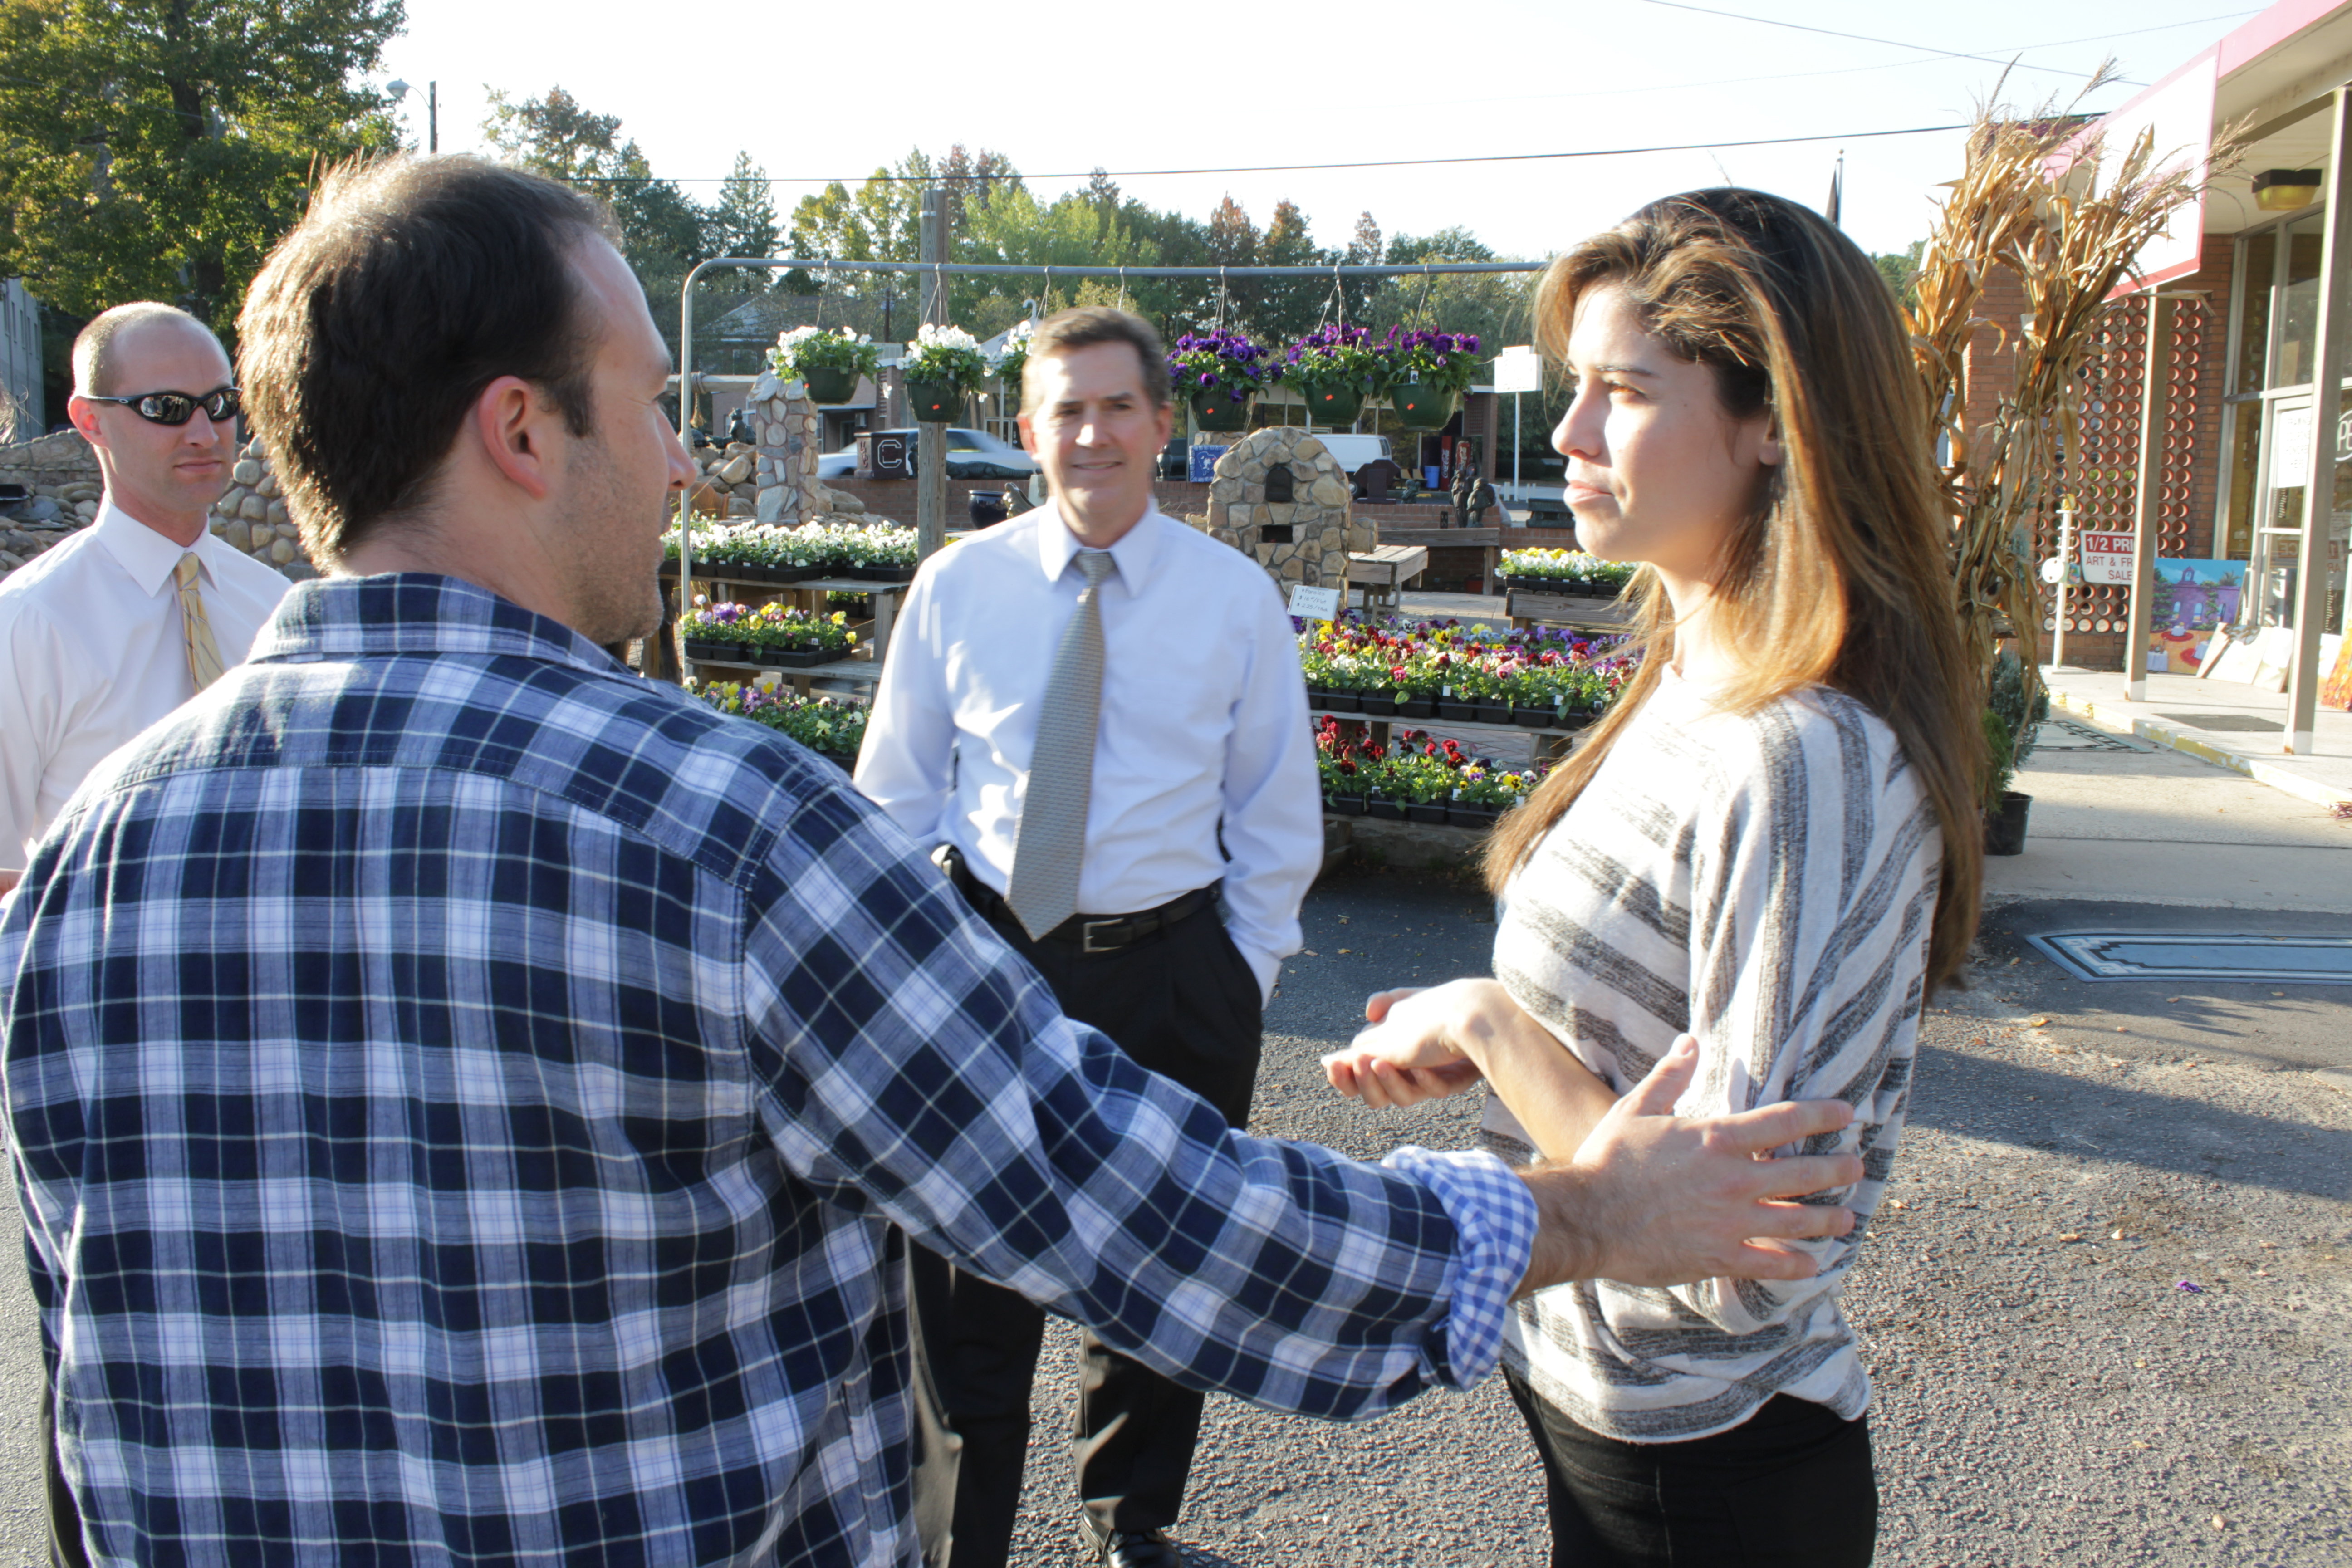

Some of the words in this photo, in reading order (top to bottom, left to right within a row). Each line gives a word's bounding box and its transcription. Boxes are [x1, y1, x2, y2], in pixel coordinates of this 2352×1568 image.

[2337, 420, 2352, 451] PE
[878, 439, 902, 468] C
[2087, 535, 2109, 551] 1/2
[2113, 538, 2134, 552] PRI
[2086, 556, 2105, 566] ART
[2110, 557, 2116, 567] &
[2108, 570, 2132, 581] SALE
